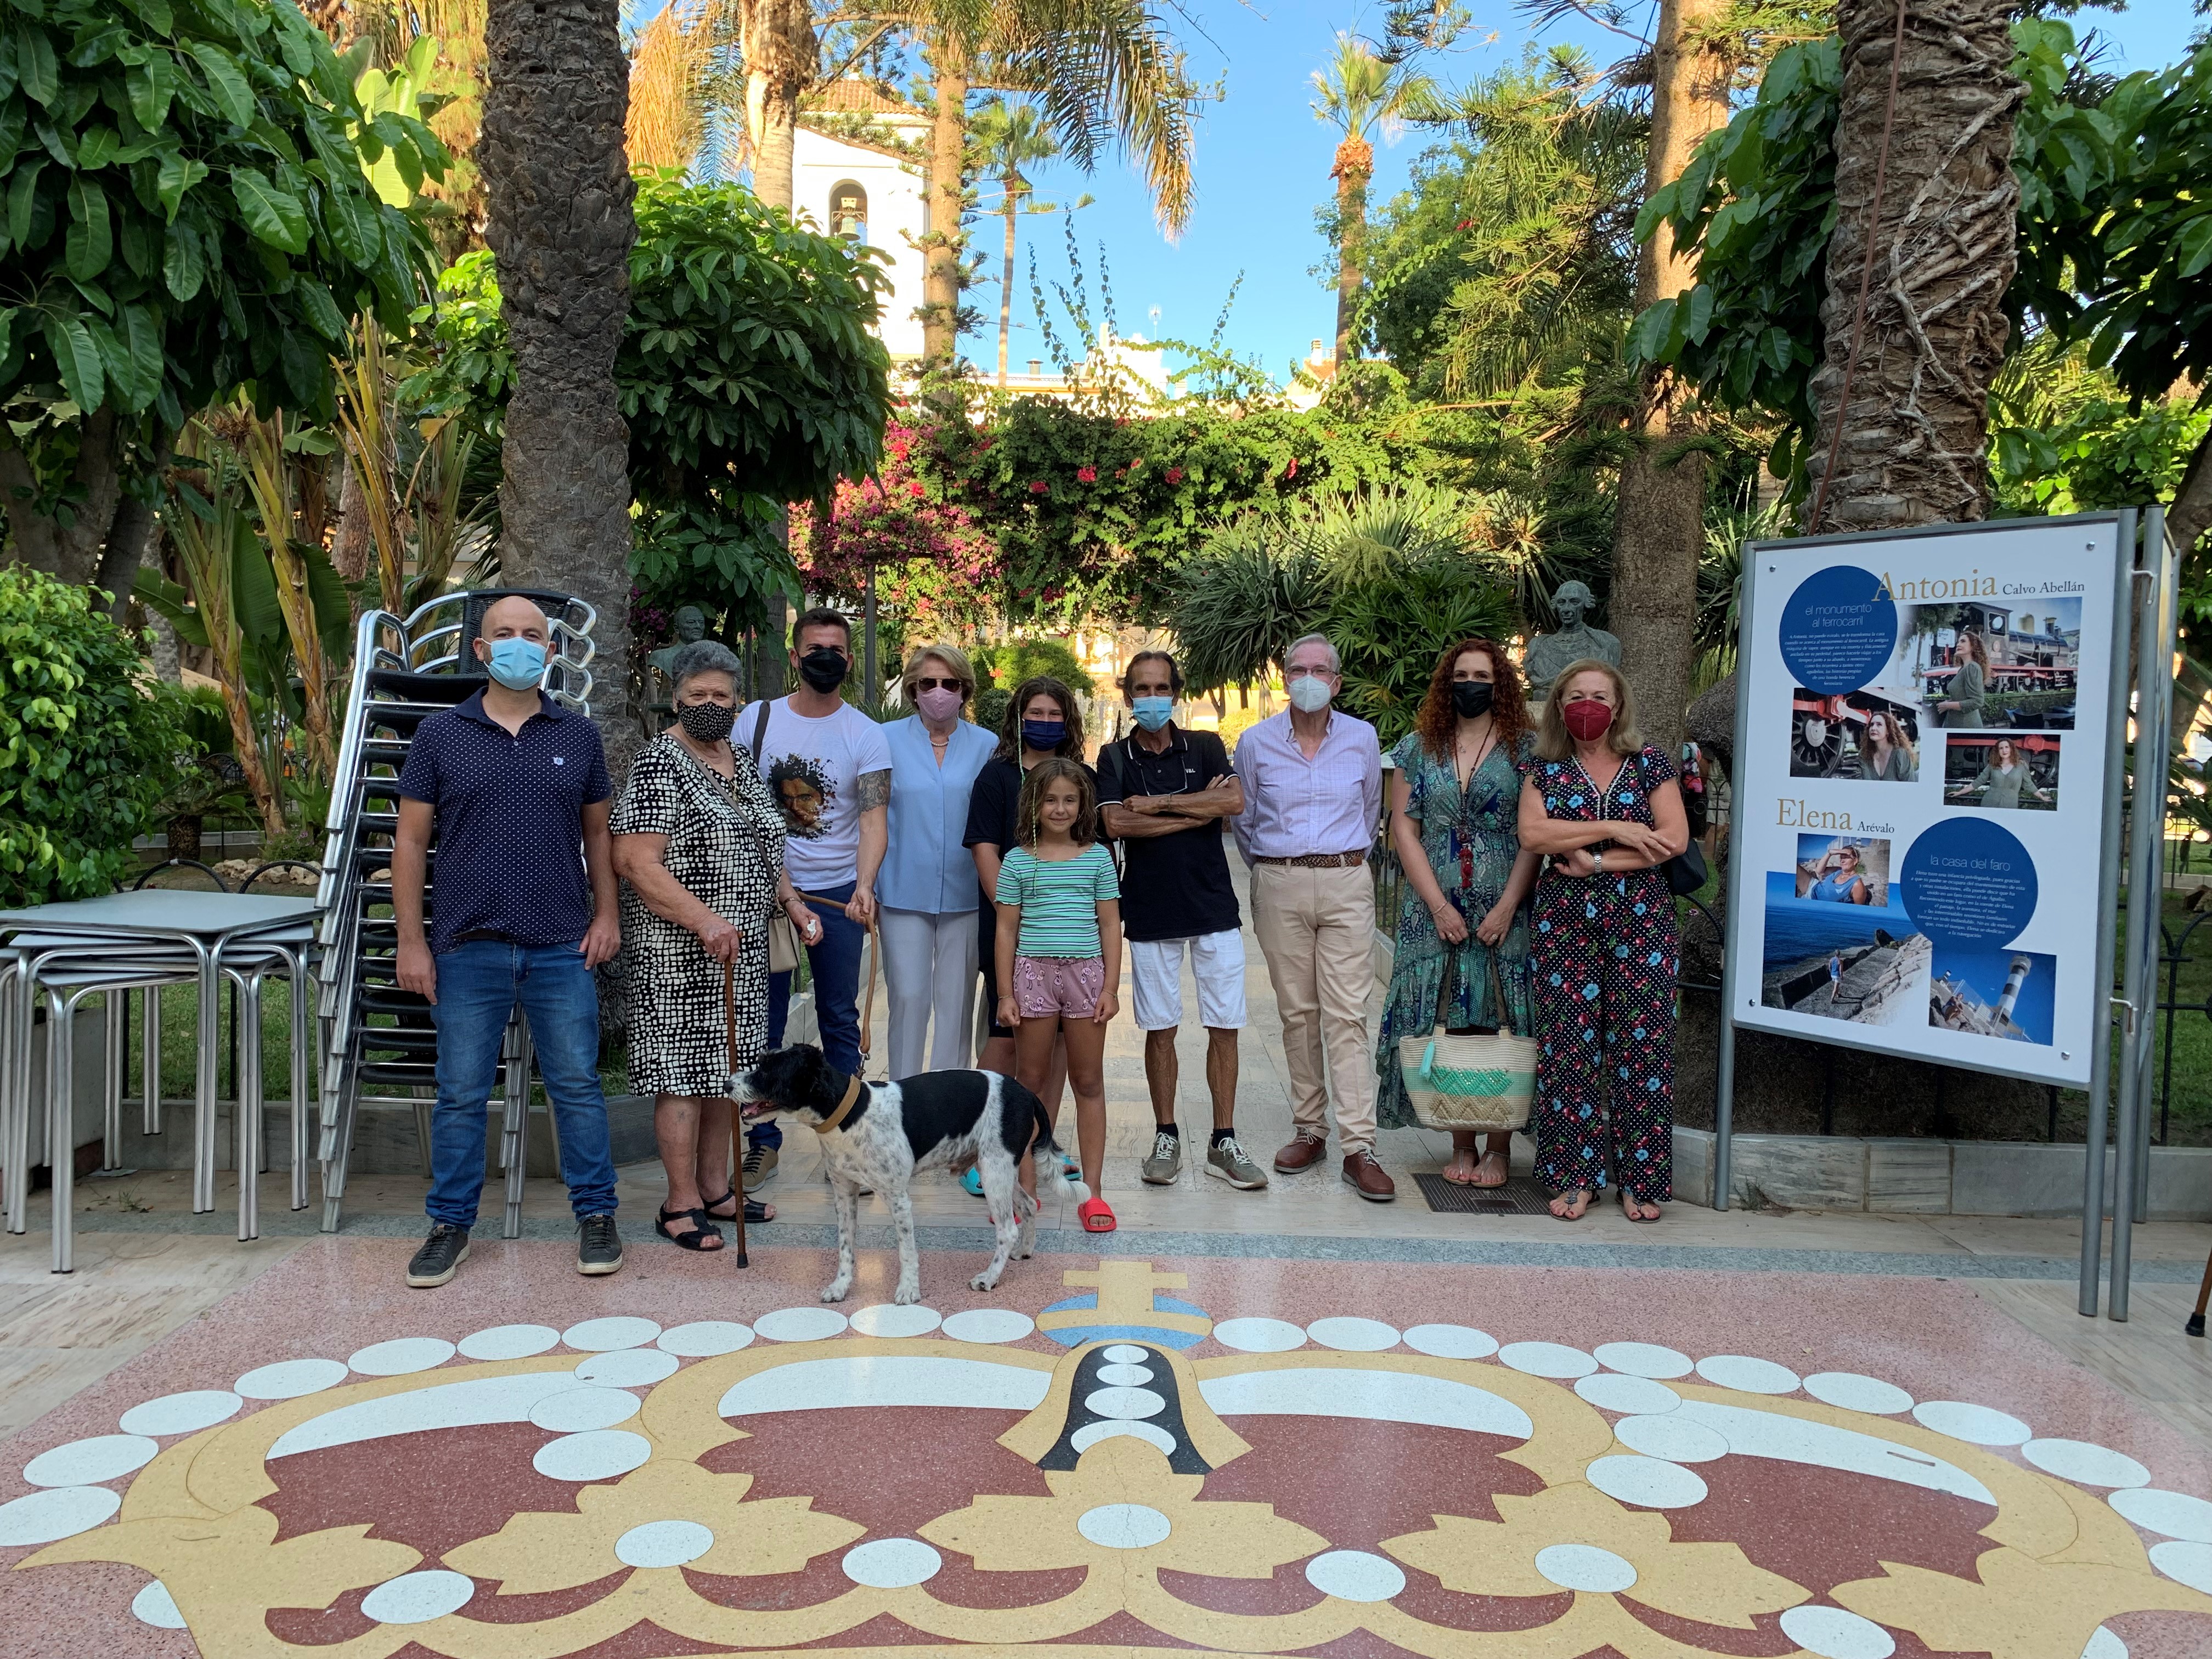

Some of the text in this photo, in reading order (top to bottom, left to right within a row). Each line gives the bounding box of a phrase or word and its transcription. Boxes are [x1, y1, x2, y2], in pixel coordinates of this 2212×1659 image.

[1871, 569, 2085, 601] Antonia Calvo Abellán
[1805, 604, 1872, 616] el monumento
[1812, 616, 1864, 628] al ferrocarril
[1776, 798, 1894, 833] Elena Arévalo
[1931, 854, 2011, 871] la casa del faro
